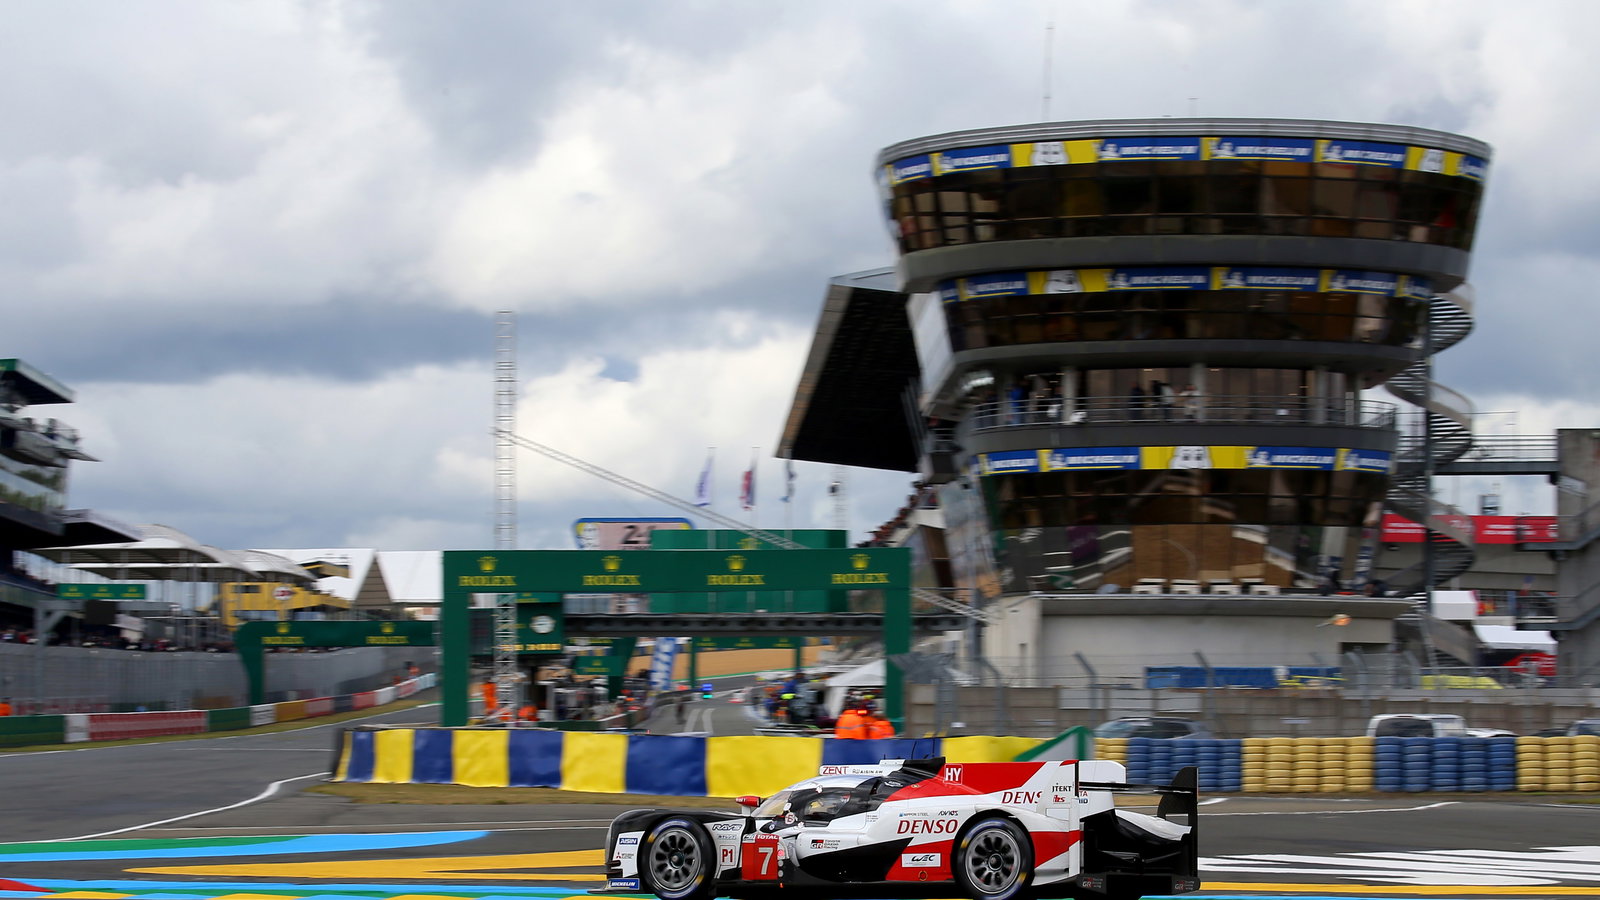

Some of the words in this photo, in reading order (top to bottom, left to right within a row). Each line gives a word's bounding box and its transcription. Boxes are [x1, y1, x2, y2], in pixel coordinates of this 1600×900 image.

[1120, 145, 1199, 155] MICHELIN
[1234, 145, 1311, 156] MICHELIN
[459, 575, 517, 586] ROLEX
[583, 575, 641, 586] ROLEX
[707, 575, 765, 585] ROLEX
[832, 573, 889, 584] ROLEX
[822, 766, 849, 775] ZENT
[945, 768, 962, 781] HY
[1052, 785, 1072, 793] JTEKT
[897, 819, 958, 834] DENSO
[722, 849, 733, 863] P1
[758, 846, 774, 875] 7
[911, 854, 935, 862] WEC
